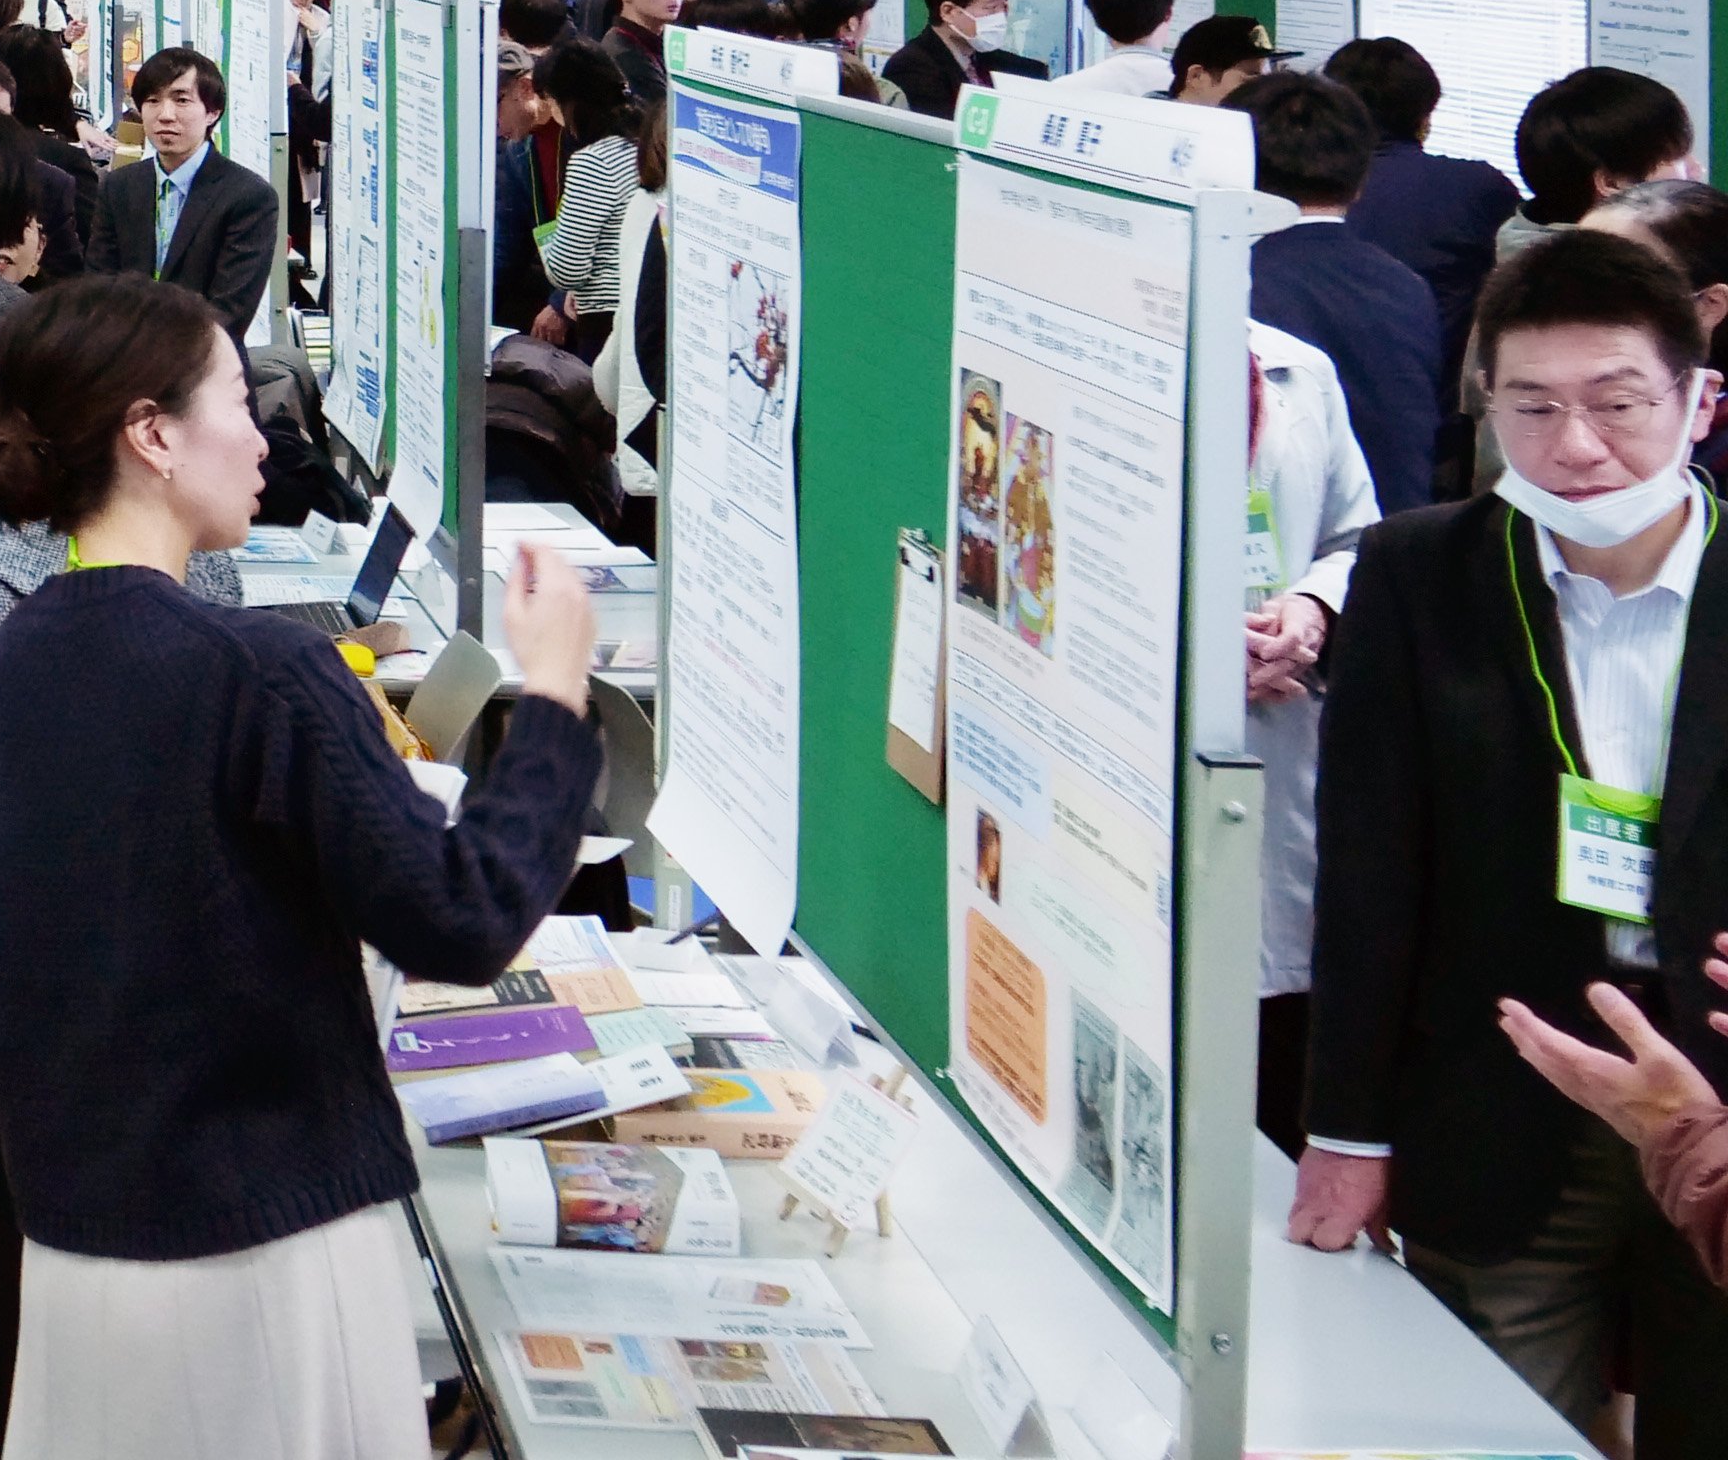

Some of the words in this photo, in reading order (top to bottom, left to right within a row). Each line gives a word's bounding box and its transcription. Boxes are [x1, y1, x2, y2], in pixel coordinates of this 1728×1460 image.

[1585, 815, 1643, 843] 出展者
[1577, 845, 1609, 866] 奥田
